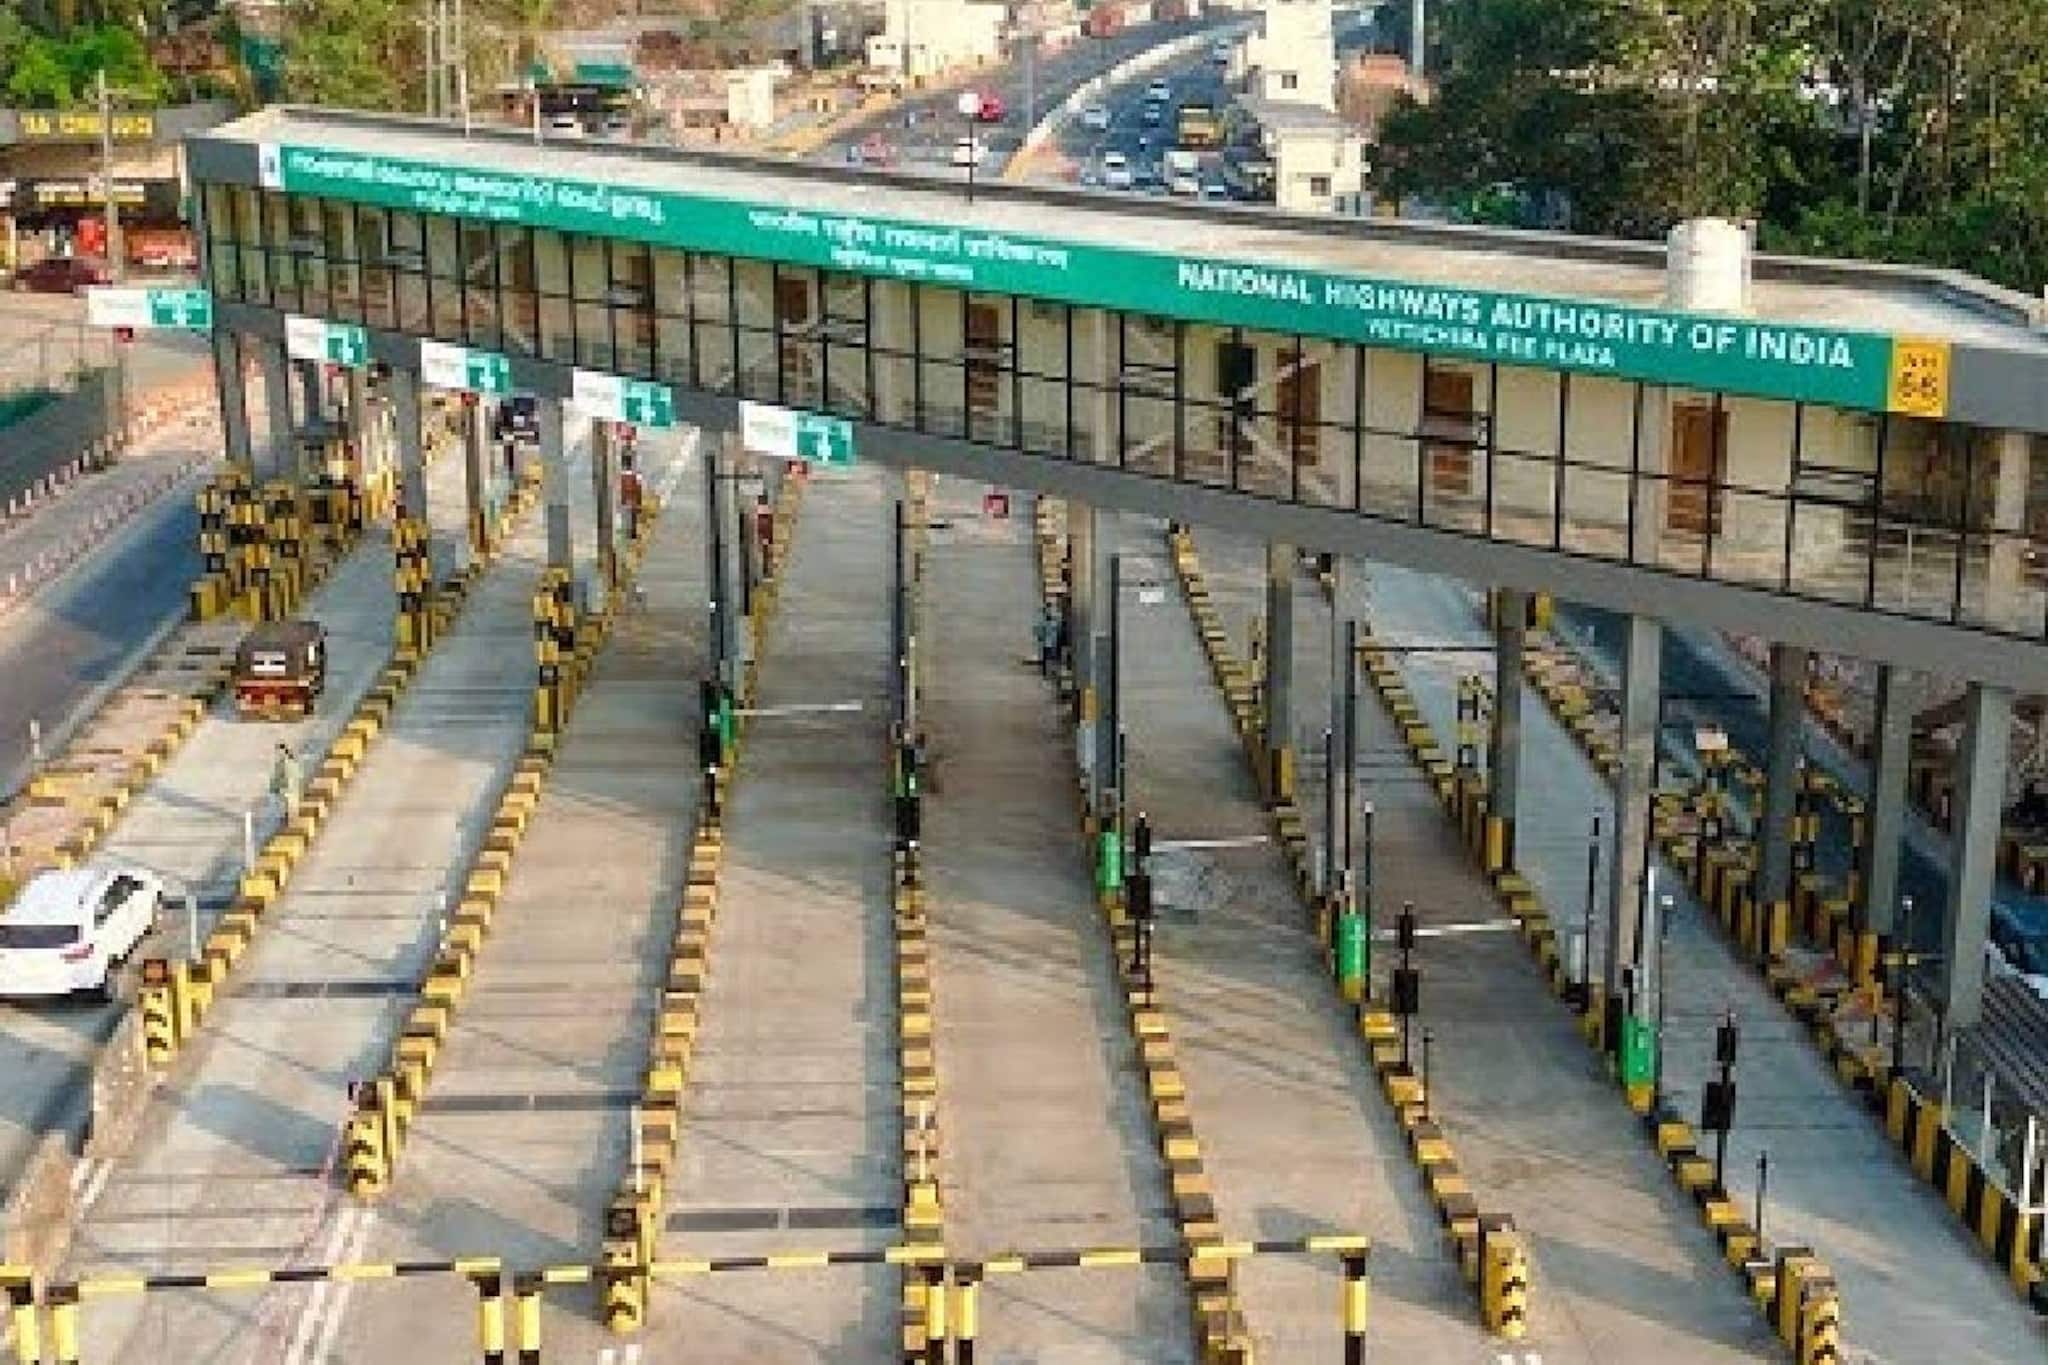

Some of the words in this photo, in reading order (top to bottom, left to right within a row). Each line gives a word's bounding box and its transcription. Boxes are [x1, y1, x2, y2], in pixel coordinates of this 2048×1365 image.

[1178, 262, 1312, 304] NATIONAL
[1325, 279, 1480, 325] HIGHWAYS
[1491, 301, 1678, 345] AUTHORITY
[1692, 323, 1736, 354] OF
[1746, 327, 1854, 368] INDIA
[1496, 332, 1537, 360] FEE
[1546, 337, 1615, 368] PLAZA
